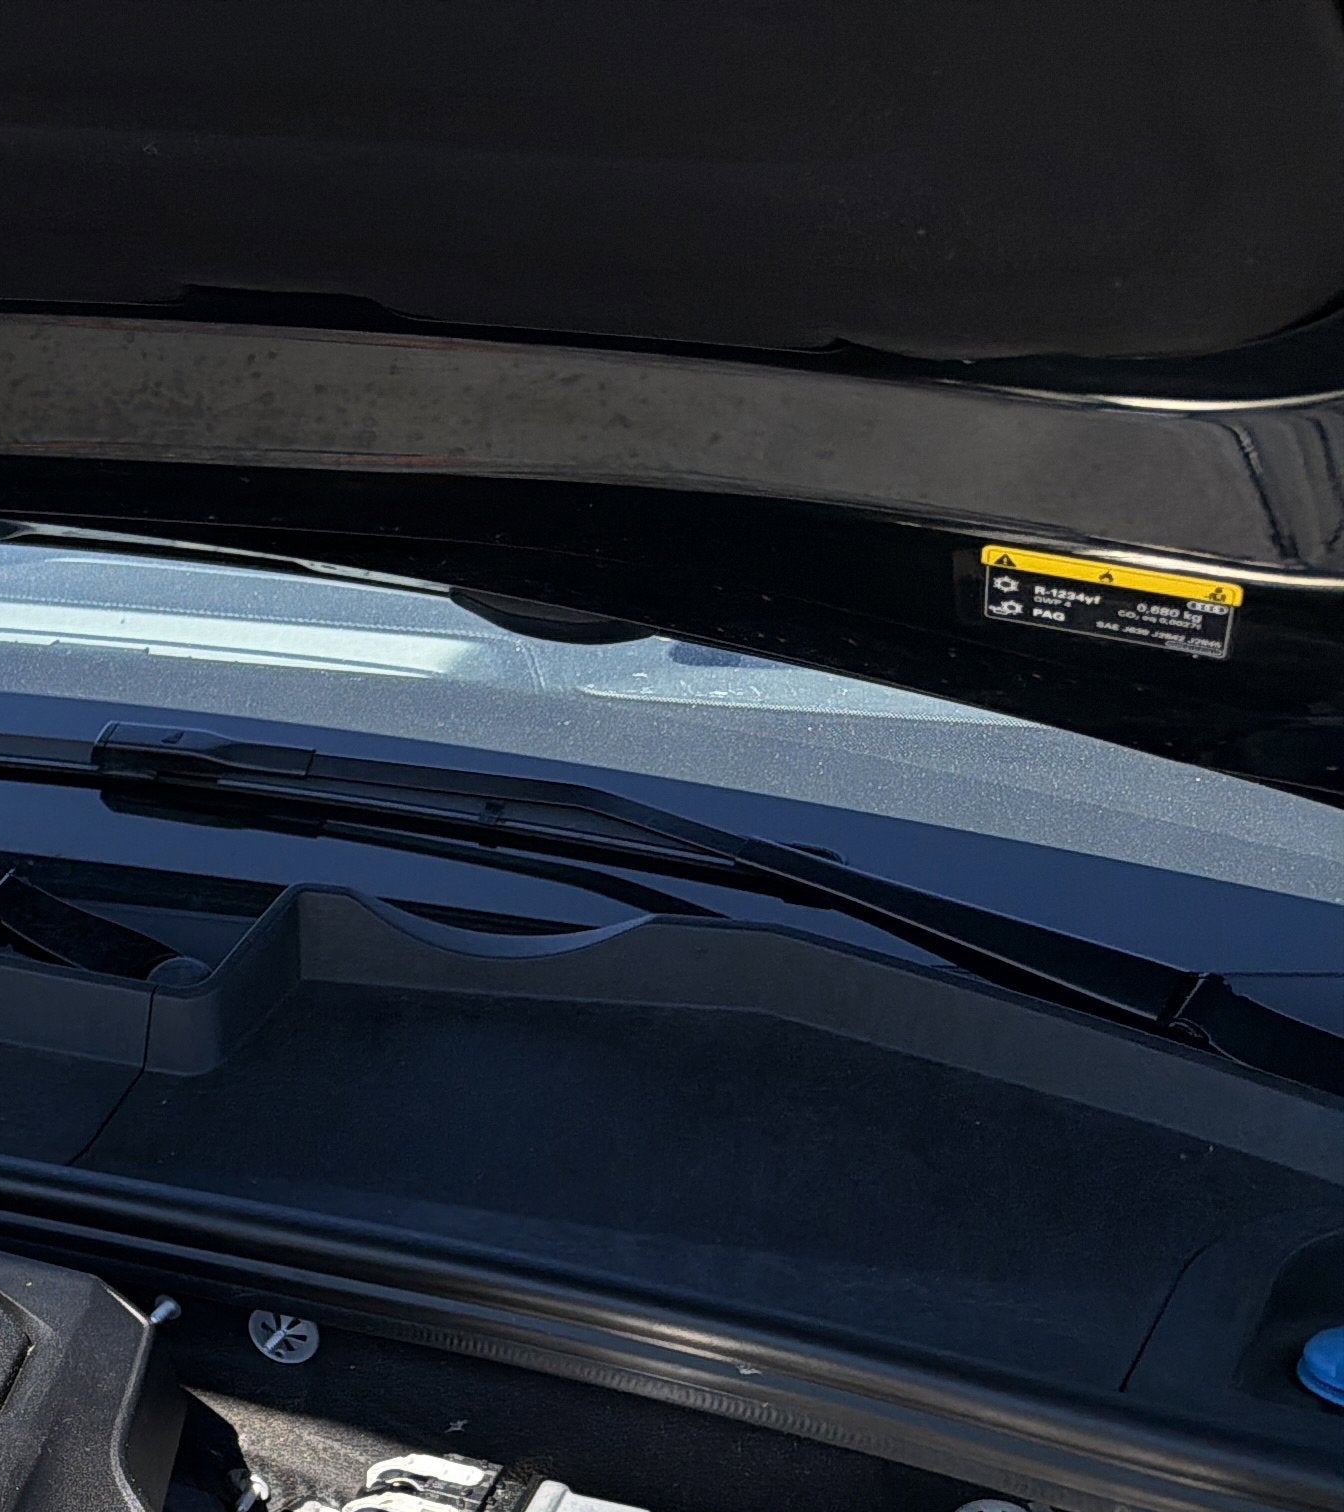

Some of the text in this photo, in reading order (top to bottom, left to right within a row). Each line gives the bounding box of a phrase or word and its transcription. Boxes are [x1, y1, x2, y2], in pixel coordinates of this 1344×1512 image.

[1034, 585, 1101, 606] R-1234yf
[1032, 608, 1065, 621] PAG
[1182, 610, 1203, 623] kg
